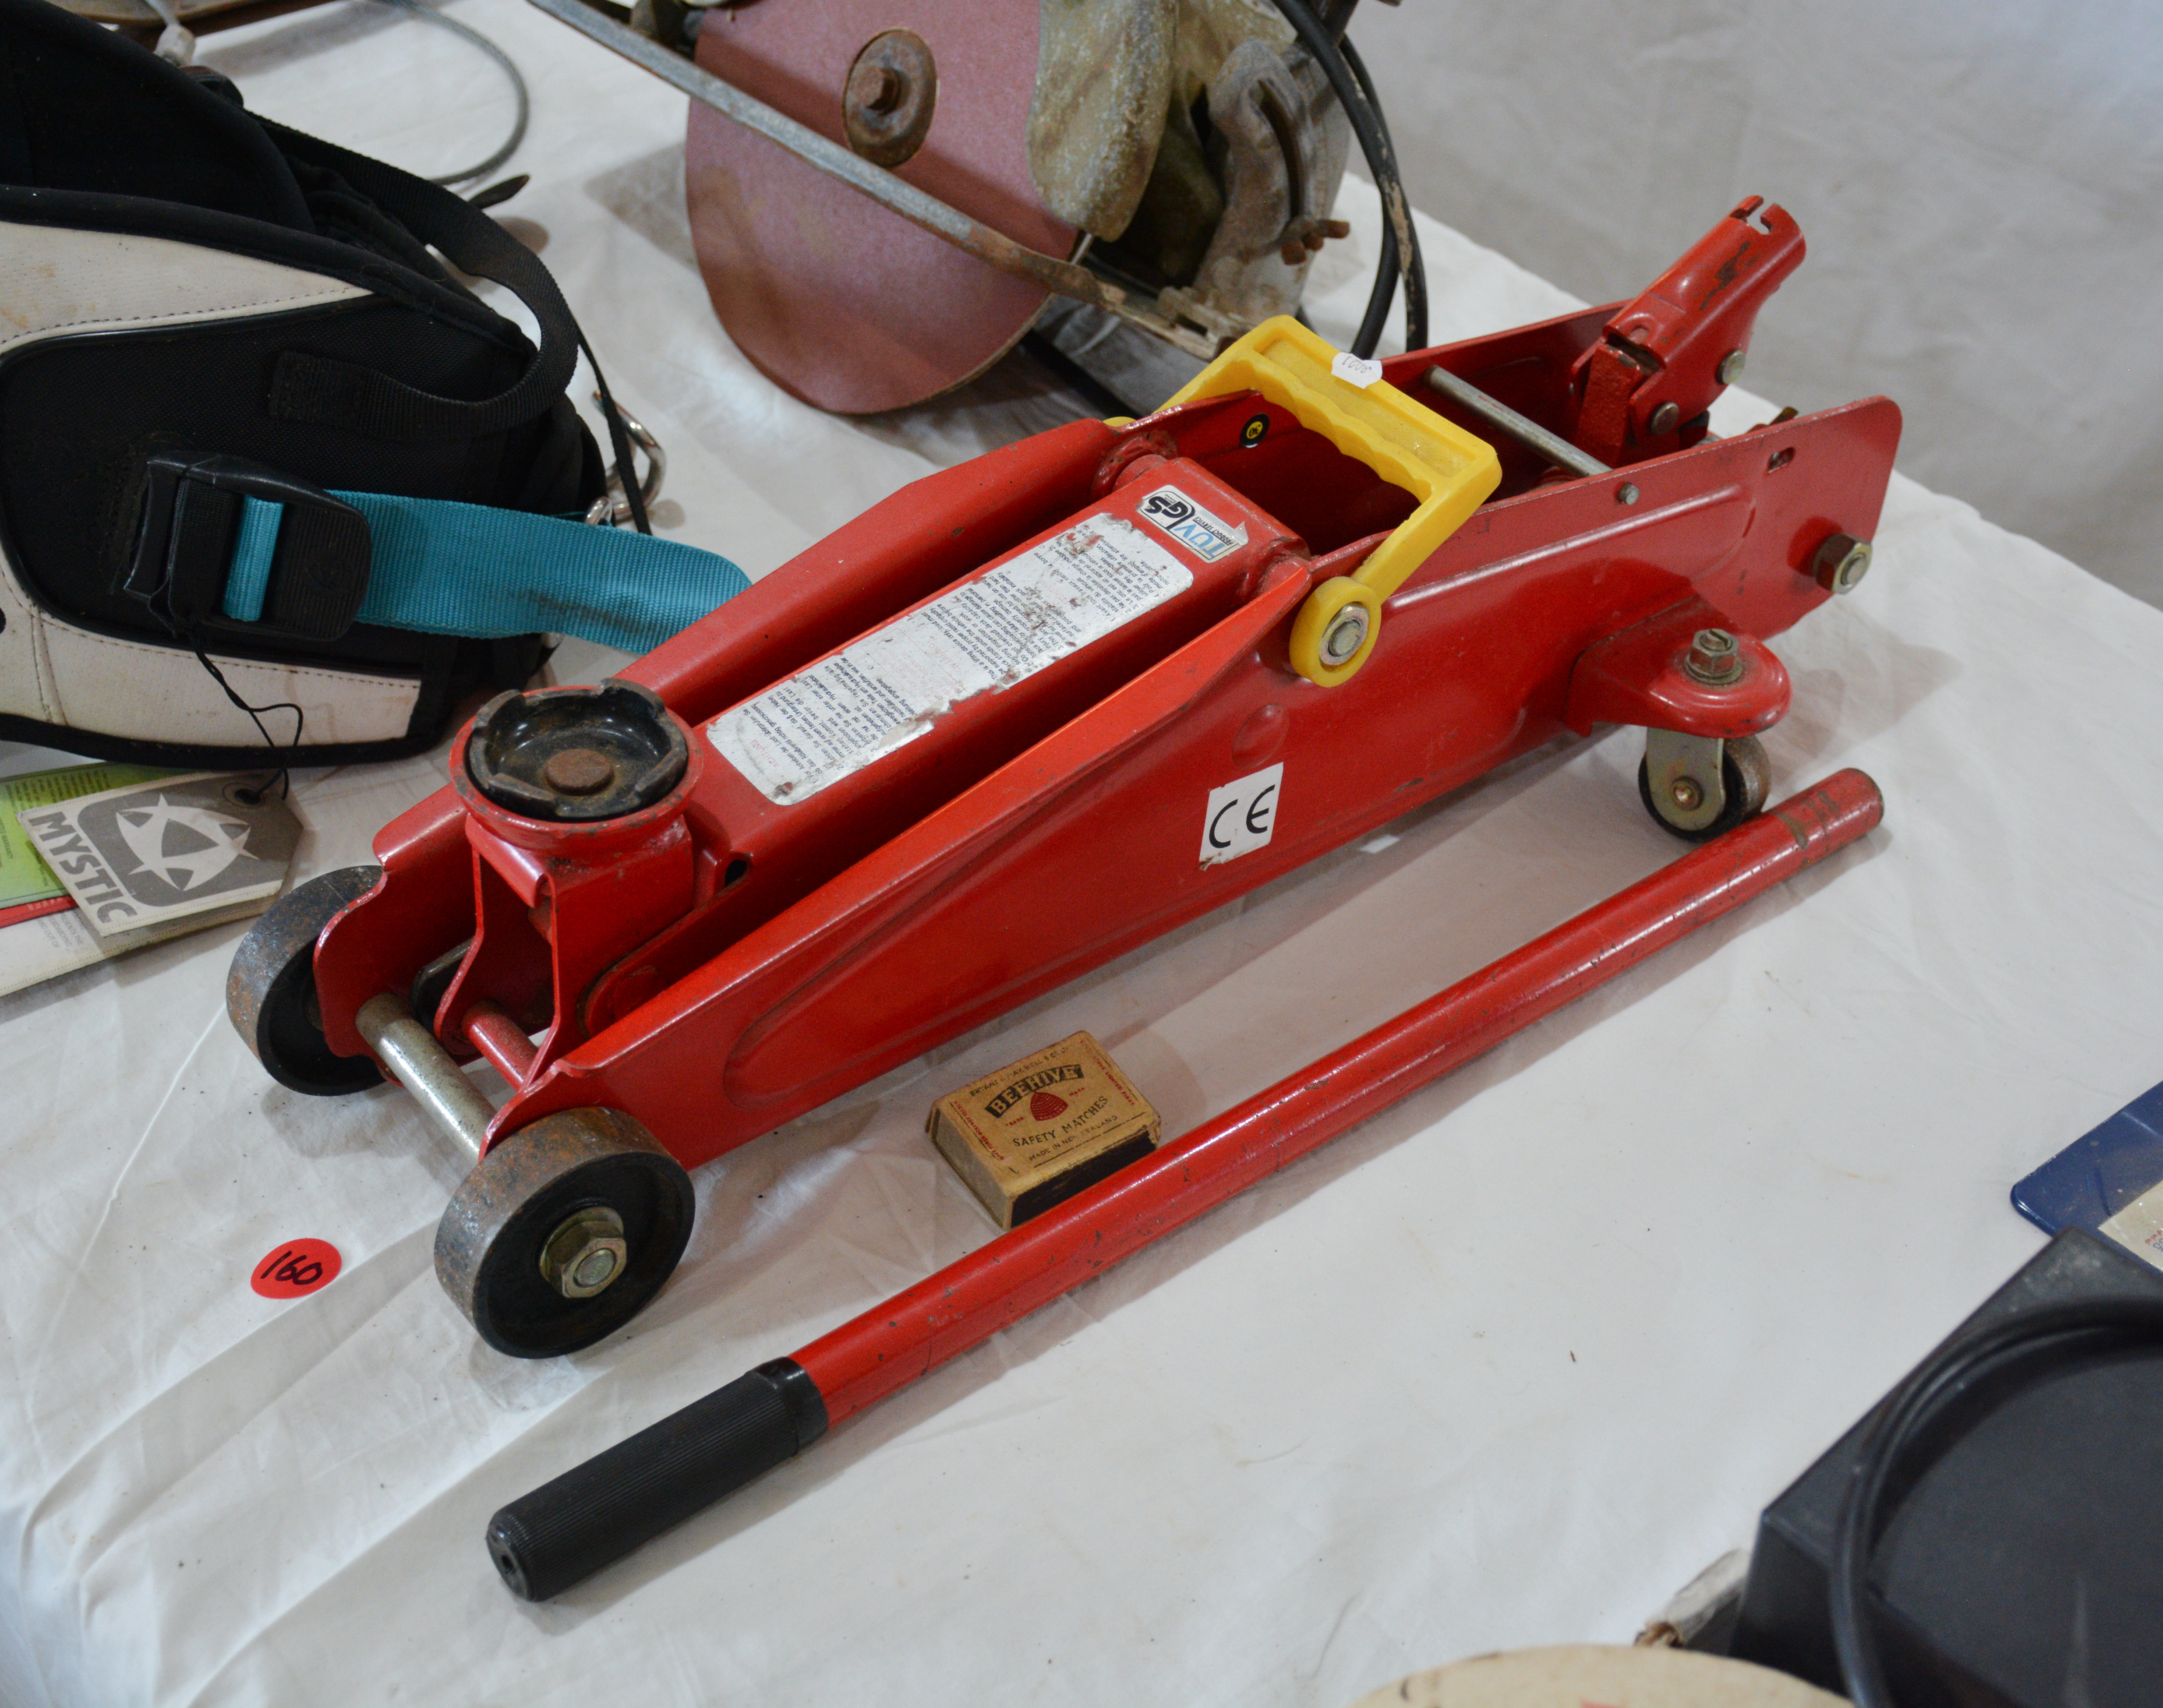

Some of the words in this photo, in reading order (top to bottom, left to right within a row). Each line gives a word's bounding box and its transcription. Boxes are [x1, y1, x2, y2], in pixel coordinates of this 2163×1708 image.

[1144, 495, 1189, 519] GS
[1194, 516, 1214, 531] SERVICE
[1174, 524, 1225, 558] TÜV
[1212, 528, 1235, 545] PRODUCT
[1071, 563, 1087, 575] charge
[988, 575, 1000, 585] hard
[1149, 577, 1163, 588] mode
[1000, 584, 1011, 593] than
[1068, 581, 1086, 596] travaux
[1085, 595, 1097, 604] tous
[920, 611, 933, 621] must
[961, 602, 980, 618] capacity
[980, 609, 994, 620] cause
[1095, 604, 1112, 616] Avant
[978, 619, 992, 629] Jack
[974, 635, 988, 646] under
[978, 628, 1002, 649] inspection
[1039, 637, 1052, 649] injury
[1048, 636, 1060, 645] This
[952, 639, 968, 652] device
[975, 649, 1000, 668] supported
[987, 670, 999, 679] This
[782, 686, 795, 697] Last
[812, 689, 823, 699] einer
[823, 700, 835, 711] unter
[862, 713, 887, 735] aufgehoben
[769, 735, 781, 746] Last
[838, 727, 862, 748] angehoben
[836, 738, 853, 753] stehen
[750, 739, 779, 767] ACHTUNG
[806, 759, 816, 768] das
[804, 770, 814, 779] Vor
[1209, 784, 1275, 848] CE
[28, 812, 138, 924] MYSTIC
[990, 1065, 1080, 1115] BEEHIVE
[1105, 1071, 1122, 1090] LIGHTED
[1121, 1091, 1135, 1106] FIRES
[1013, 1130, 1056, 1147] SAFETY
[1062, 1096, 1109, 1133] MATCHES
[1029, 1148, 1051, 1161] MADE
[1062, 1134, 1078, 1144] NEW
[260, 1251, 323, 1285] 160
